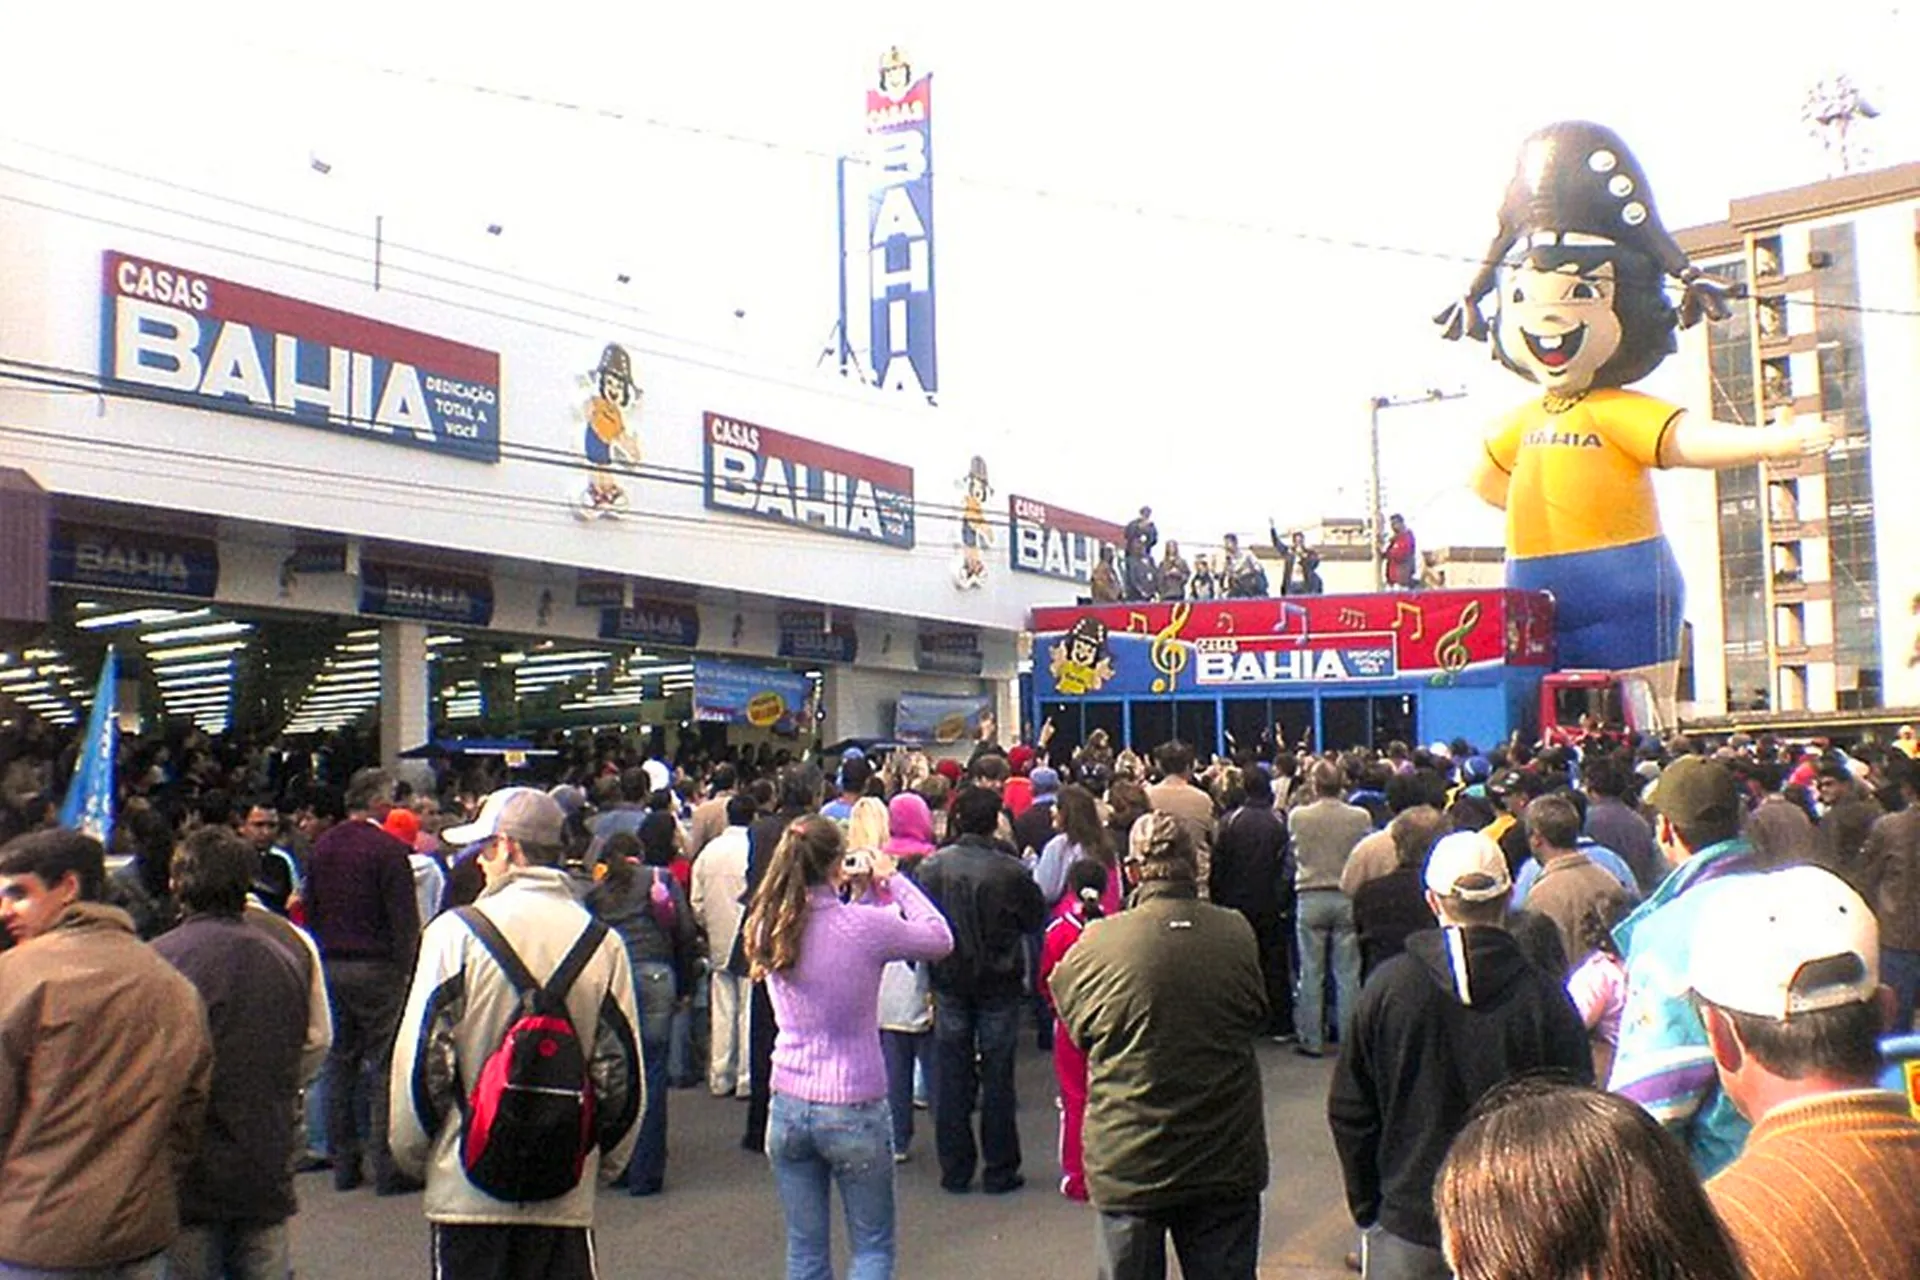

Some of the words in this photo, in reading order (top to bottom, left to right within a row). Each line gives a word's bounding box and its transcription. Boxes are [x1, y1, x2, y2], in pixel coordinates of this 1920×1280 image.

[867, 99, 925, 133] CASAS
[868, 129, 934, 400] BAHIA
[118, 261, 209, 311] CASAS
[114, 293, 437, 442] BAHIA
[426, 376, 496, 405] DEDICAÇÃO
[435, 398, 475, 421] TOTAL
[476, 410, 488, 424] A
[711, 418, 761, 452] CASAS
[712, 443, 884, 539] BAHIA
[1014, 499, 1047, 524] CASAS
[76, 542, 189, 580] BAHIA
[1197, 648, 1351, 682] BAHIA
